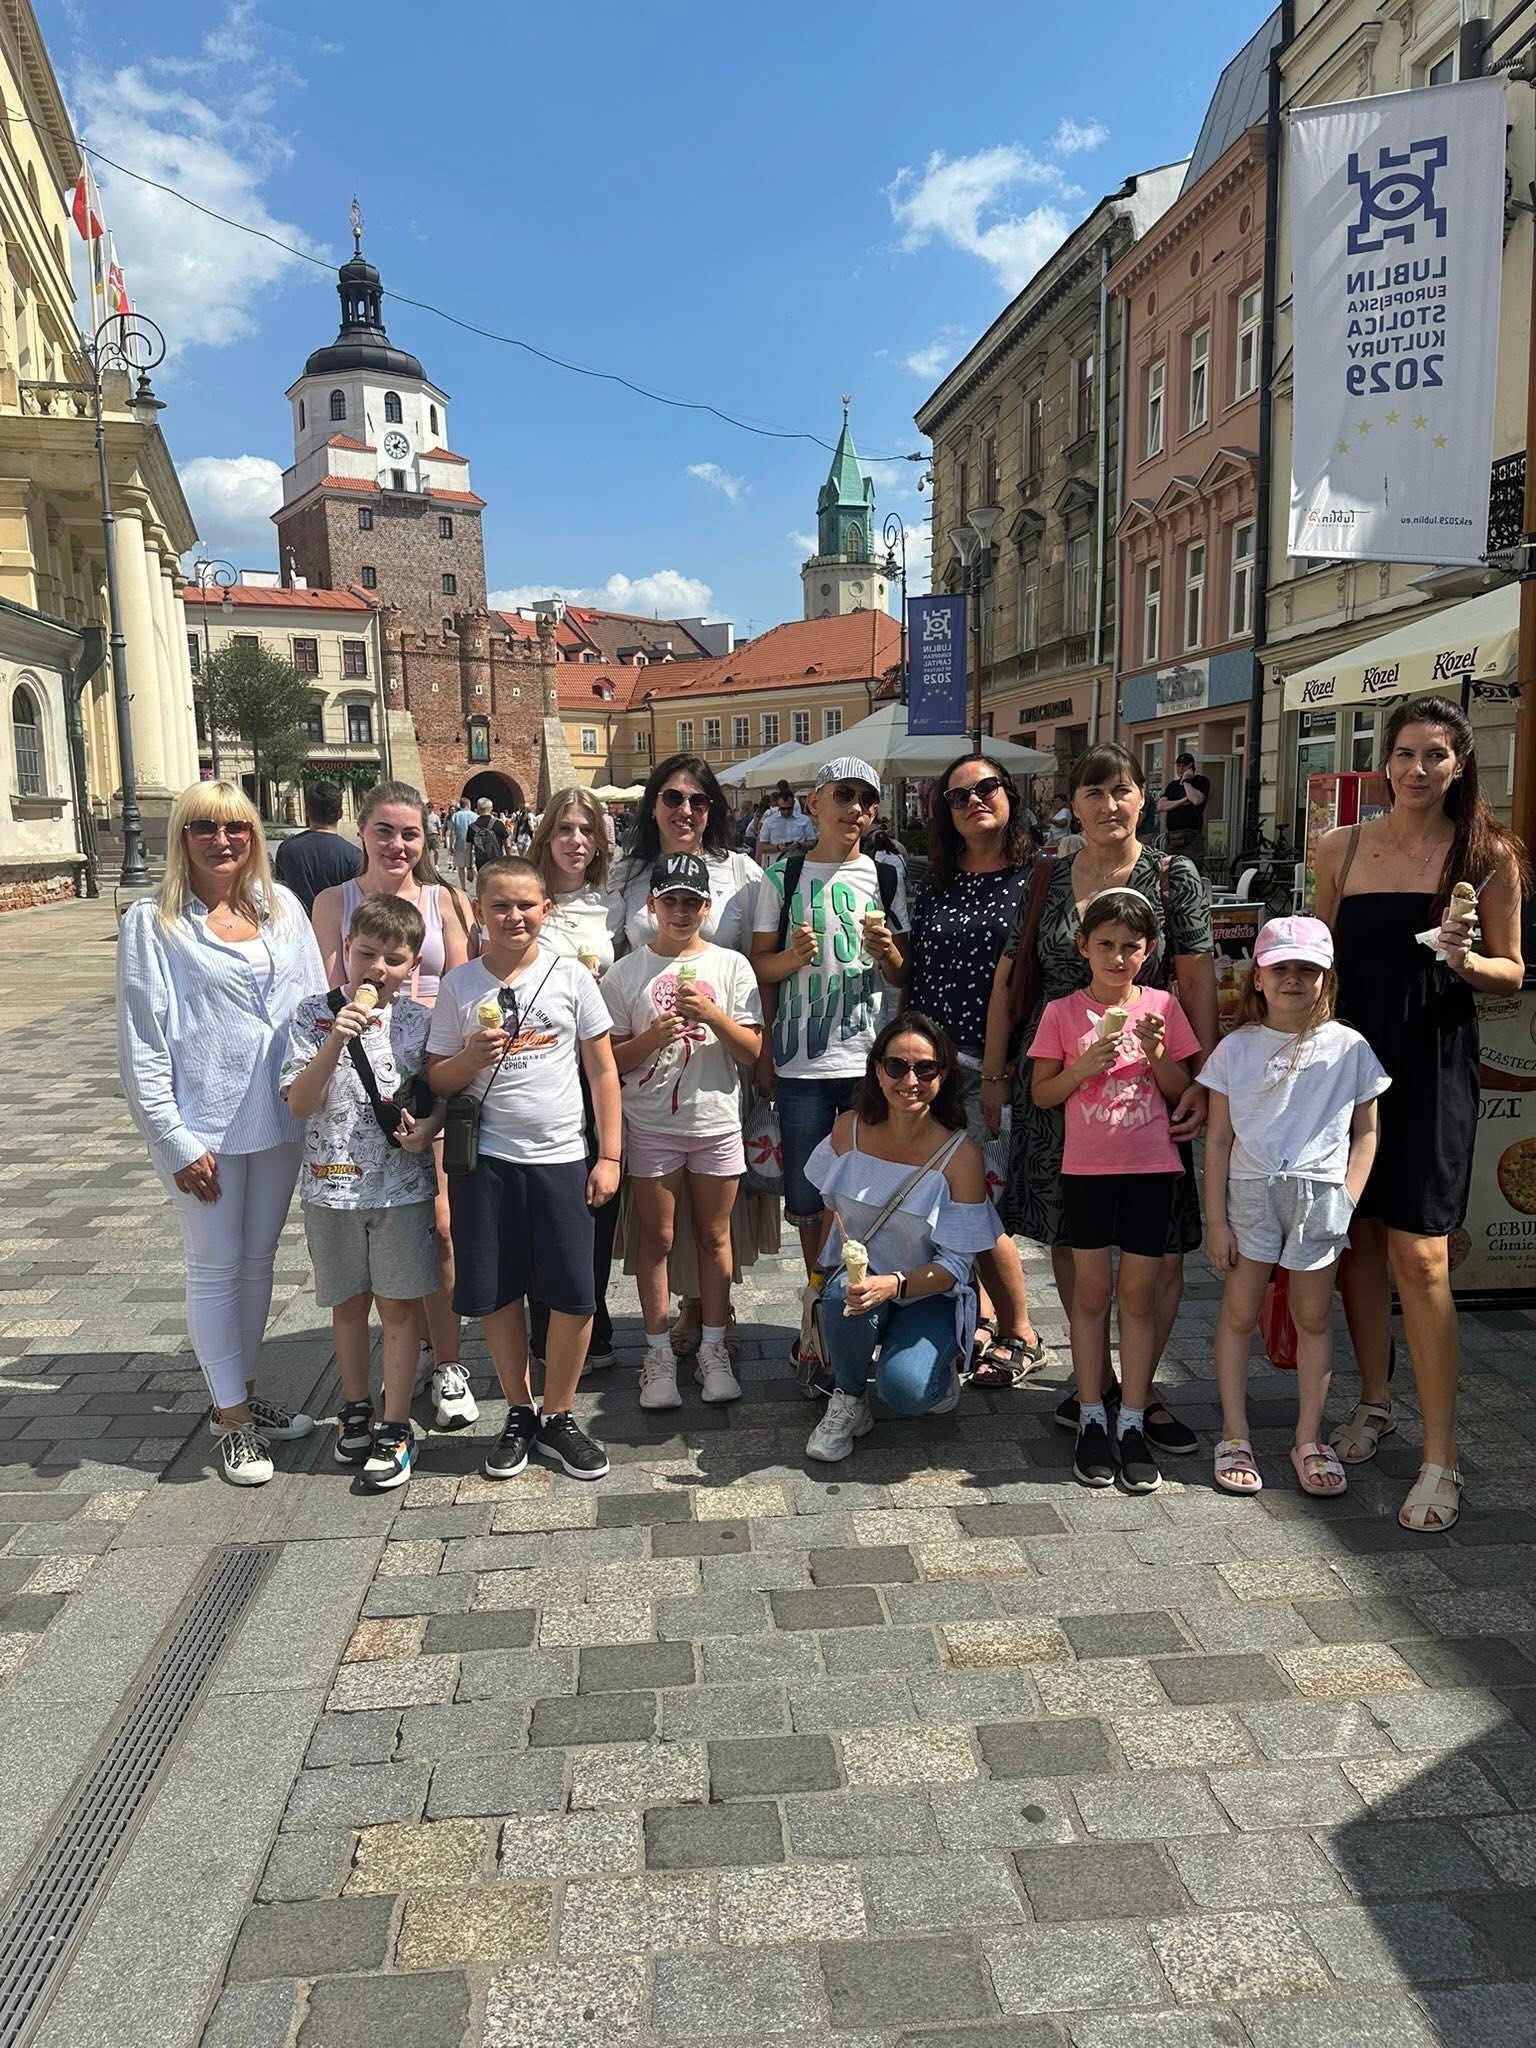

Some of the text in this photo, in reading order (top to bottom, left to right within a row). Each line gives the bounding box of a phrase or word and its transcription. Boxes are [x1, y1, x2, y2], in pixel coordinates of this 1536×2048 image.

[1431, 646, 1479, 681] Kozel
[1301, 676, 1336, 703] Kozel
[1361, 663, 1400, 693] Kozel
[667, 855, 700, 876] VIP
[1489, 1239, 1536, 1251] Chmie
